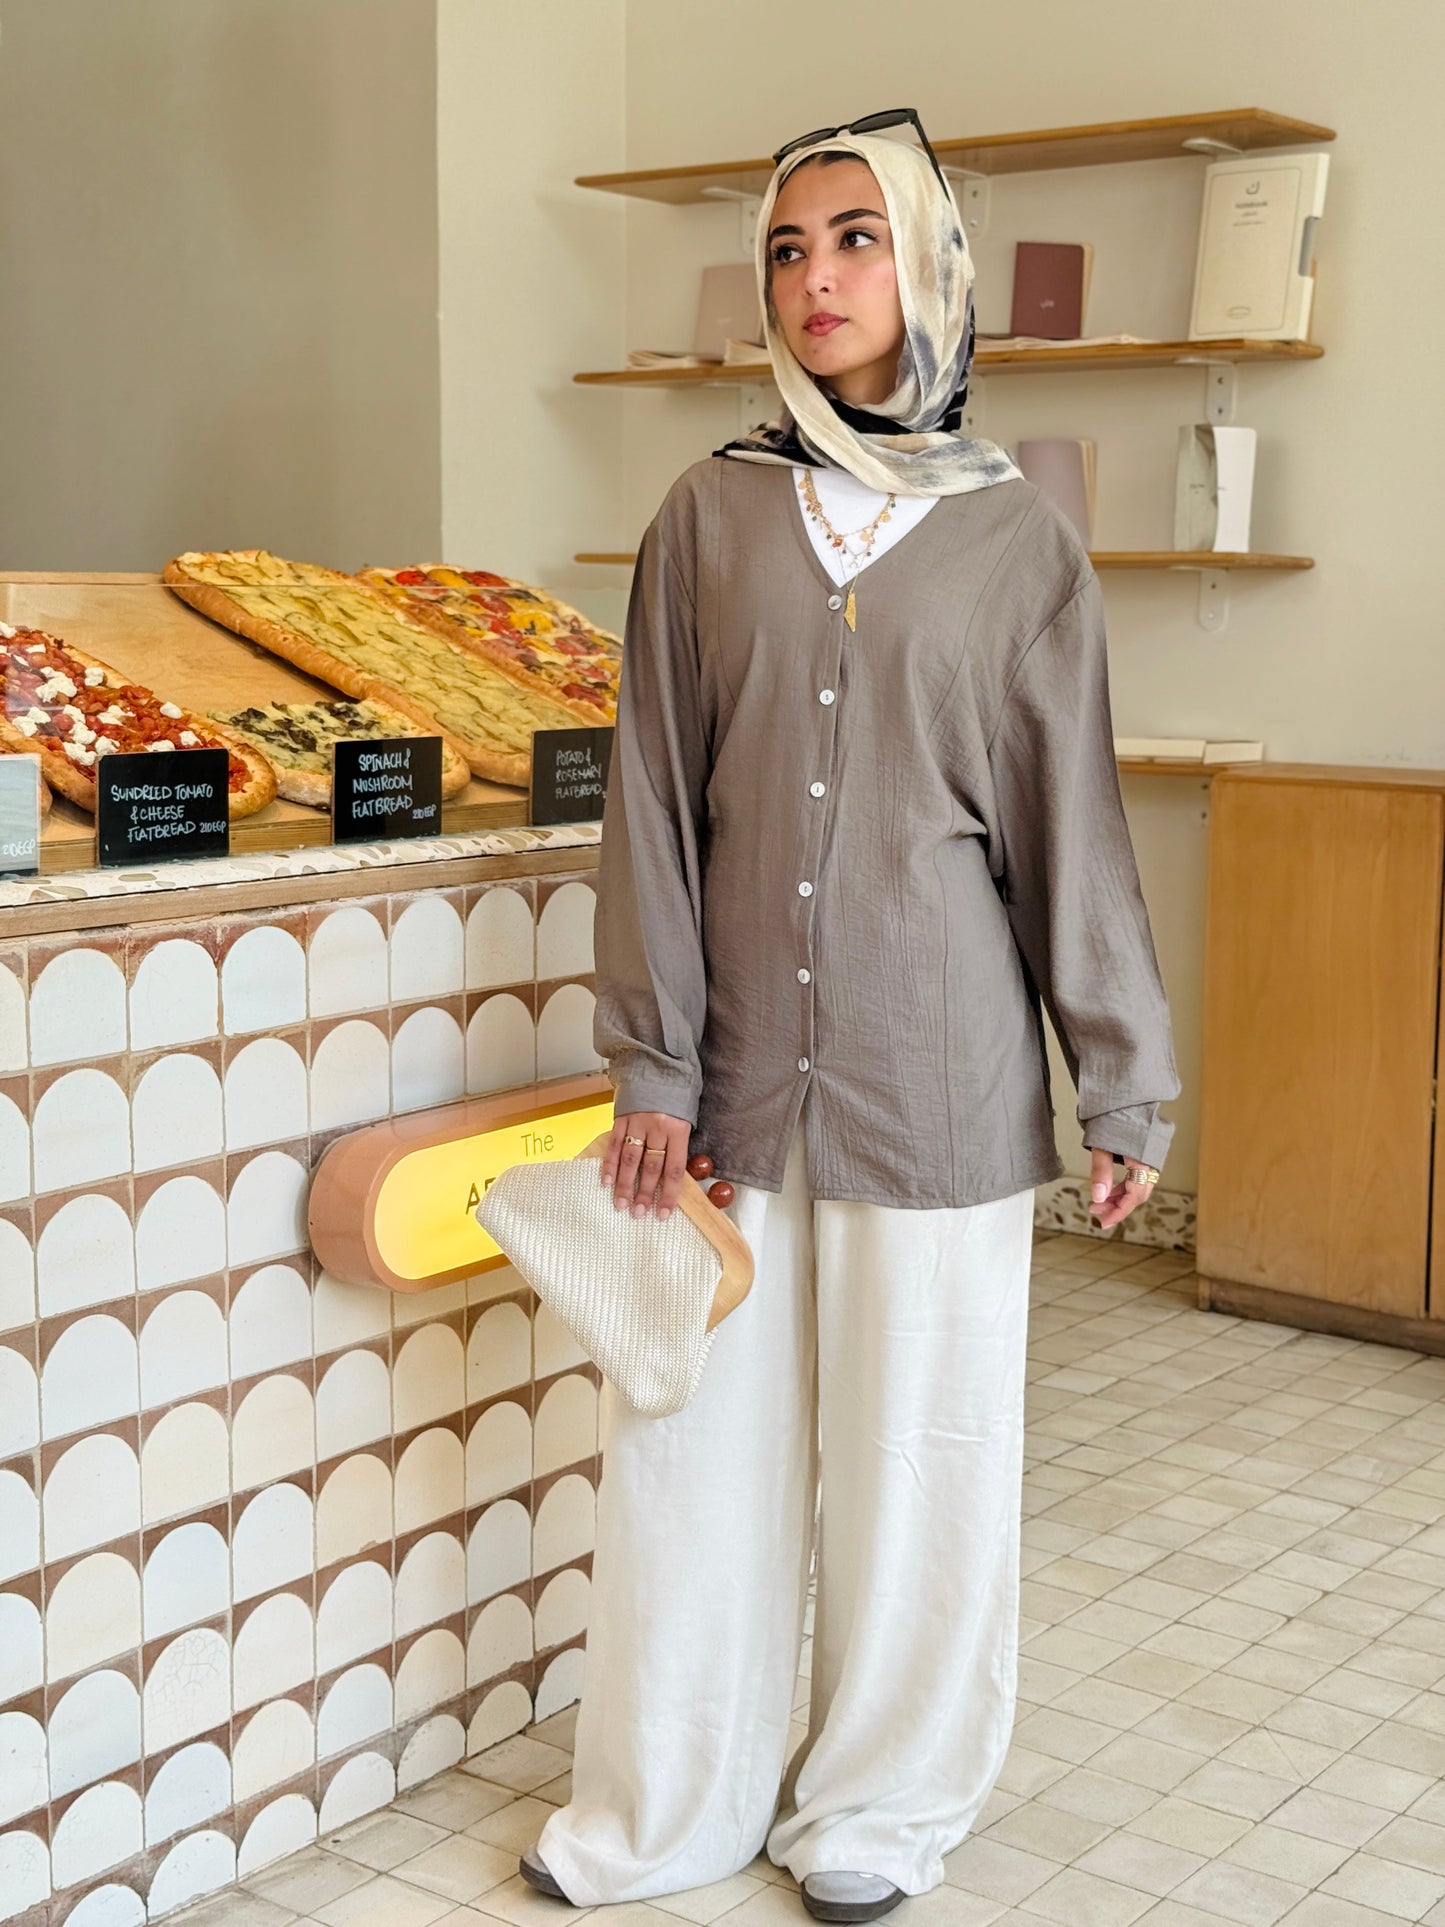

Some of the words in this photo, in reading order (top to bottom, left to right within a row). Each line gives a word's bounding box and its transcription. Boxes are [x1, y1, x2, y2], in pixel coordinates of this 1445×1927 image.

[358, 752, 402, 772] SPINACH
[111, 784, 173, 802] SUNDRIED
[174, 783, 214, 800] TOMATO
[352, 795, 413, 819] FLATBREAD
[127, 821, 196, 843] FLATBREAD
[521, 1131, 555, 1157] The
